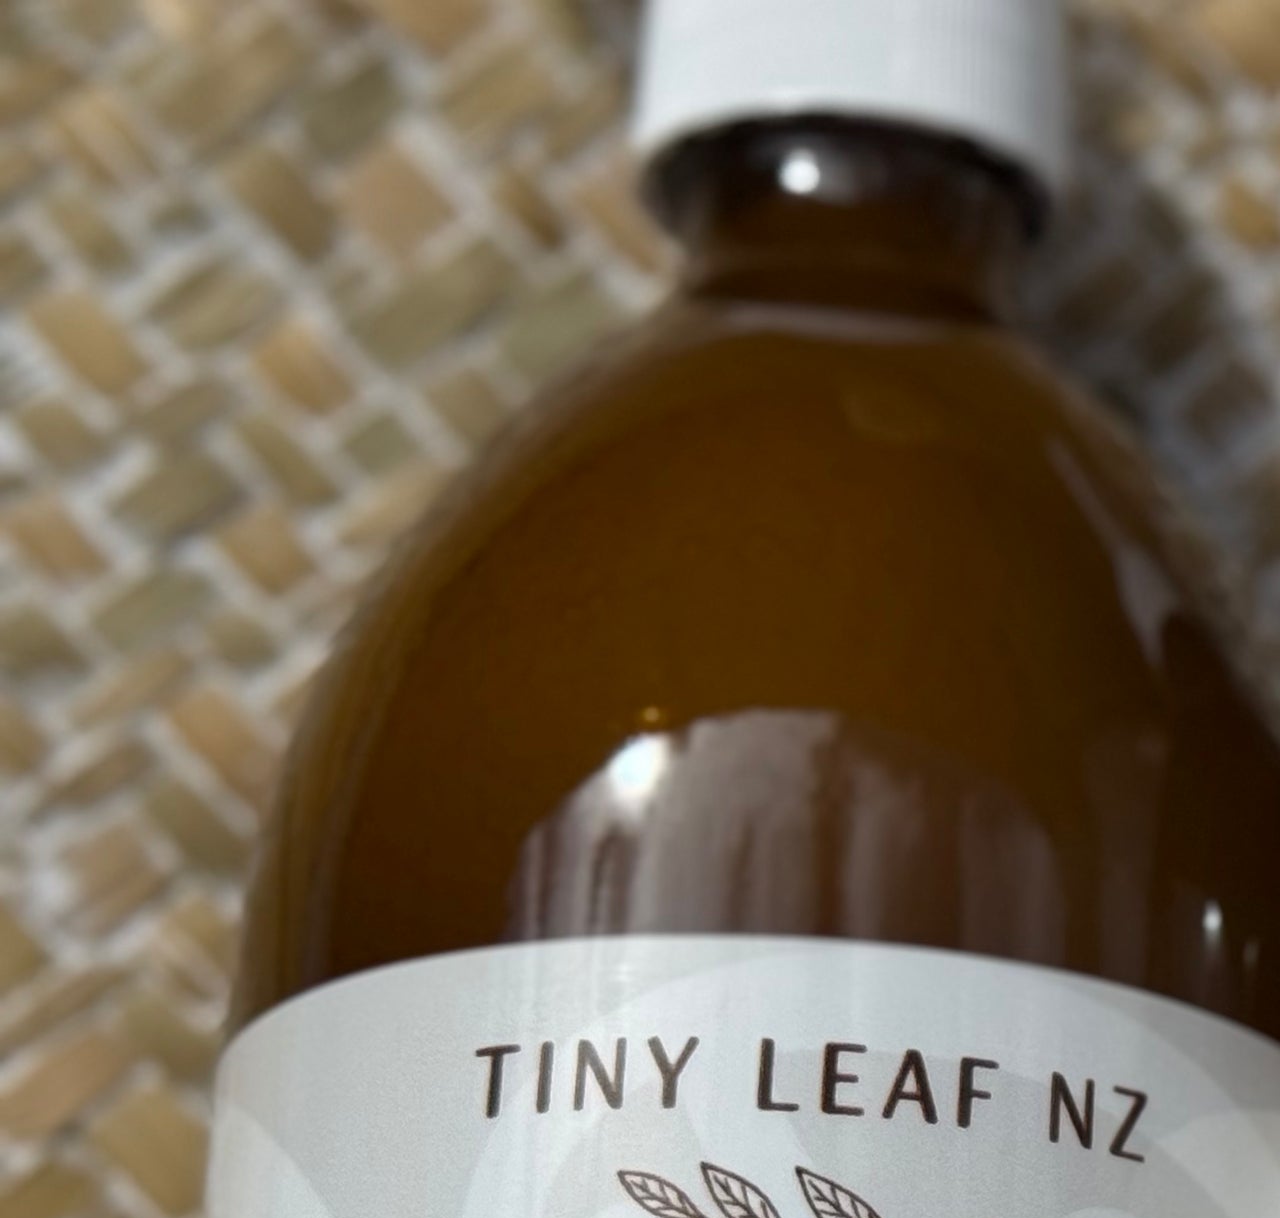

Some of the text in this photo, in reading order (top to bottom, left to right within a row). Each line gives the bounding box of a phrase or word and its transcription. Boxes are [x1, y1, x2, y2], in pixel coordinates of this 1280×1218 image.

[474, 1036, 1148, 1163] TINY LEAF NZ
